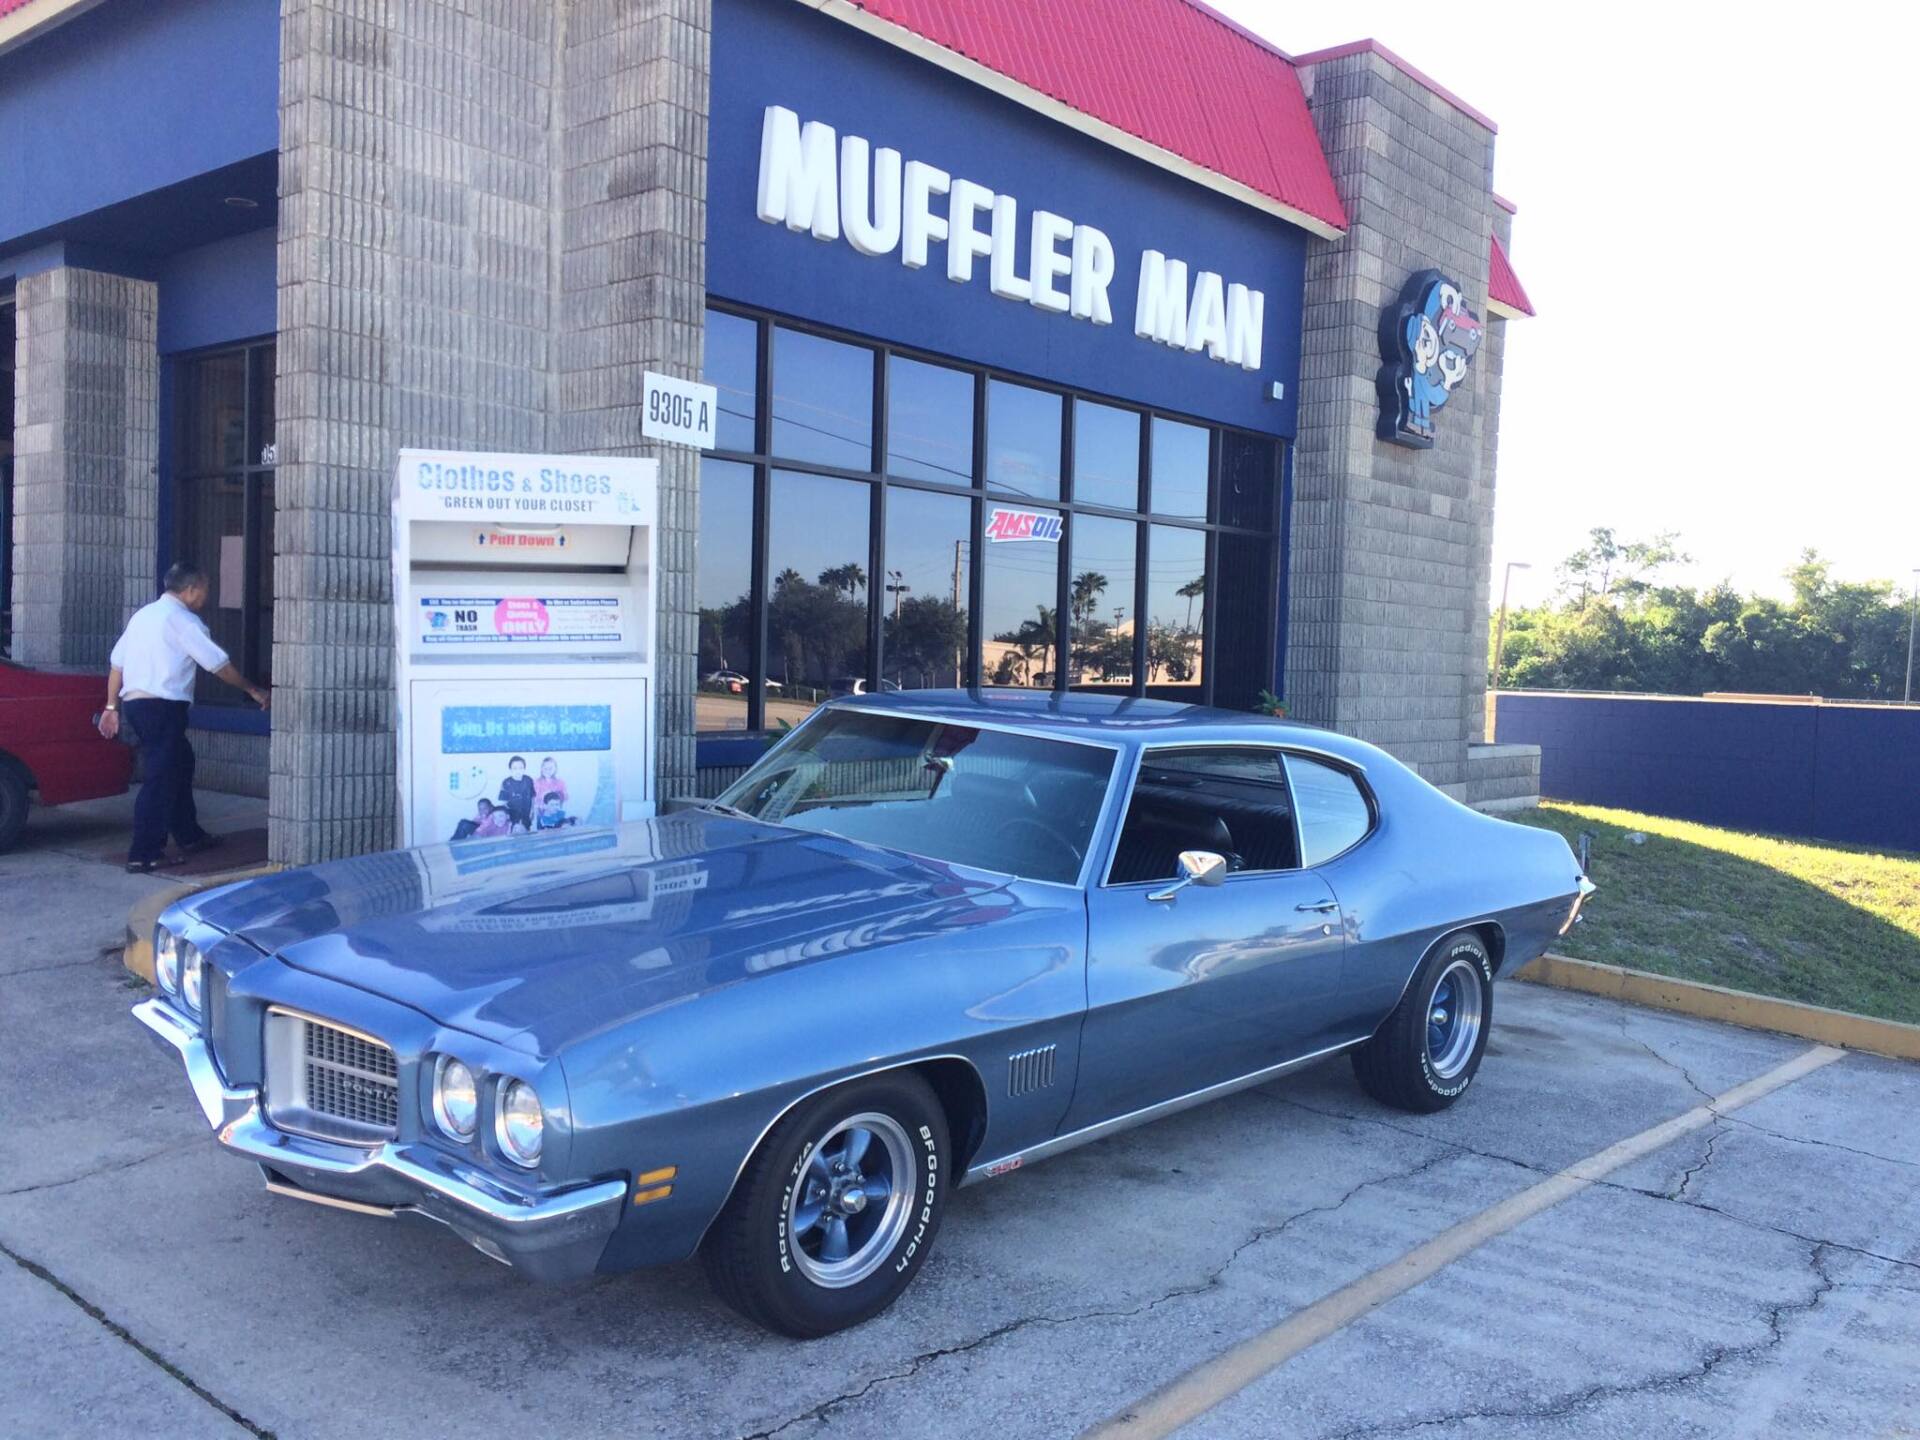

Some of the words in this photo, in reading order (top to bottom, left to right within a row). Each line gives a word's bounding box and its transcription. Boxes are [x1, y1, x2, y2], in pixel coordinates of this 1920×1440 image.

[757, 105, 1115, 325] MUFFLER
[1135, 250, 1264, 370] MAN
[650, 389, 693, 430] 9305
[698, 401, 708, 433] A
[418, 462, 514, 492] Clothes
[522, 477, 532, 492] &
[540, 469, 611, 495] Shoes
[487, 497, 510, 510] OUT
[514, 497, 547, 511] YOUR
[519, 534, 555, 546] Down
[986, 511, 1062, 540] AMSOIL
[454, 610, 478, 623] NO
[456, 624, 477, 632] TRASH
[1451, 944, 1482, 958] Radial
[1481, 955, 1492, 982] T/A
[778, 1185, 792, 1273] Radial
[791, 1142, 813, 1177] T/A
[896, 1125, 937, 1273] BFGoodrich
